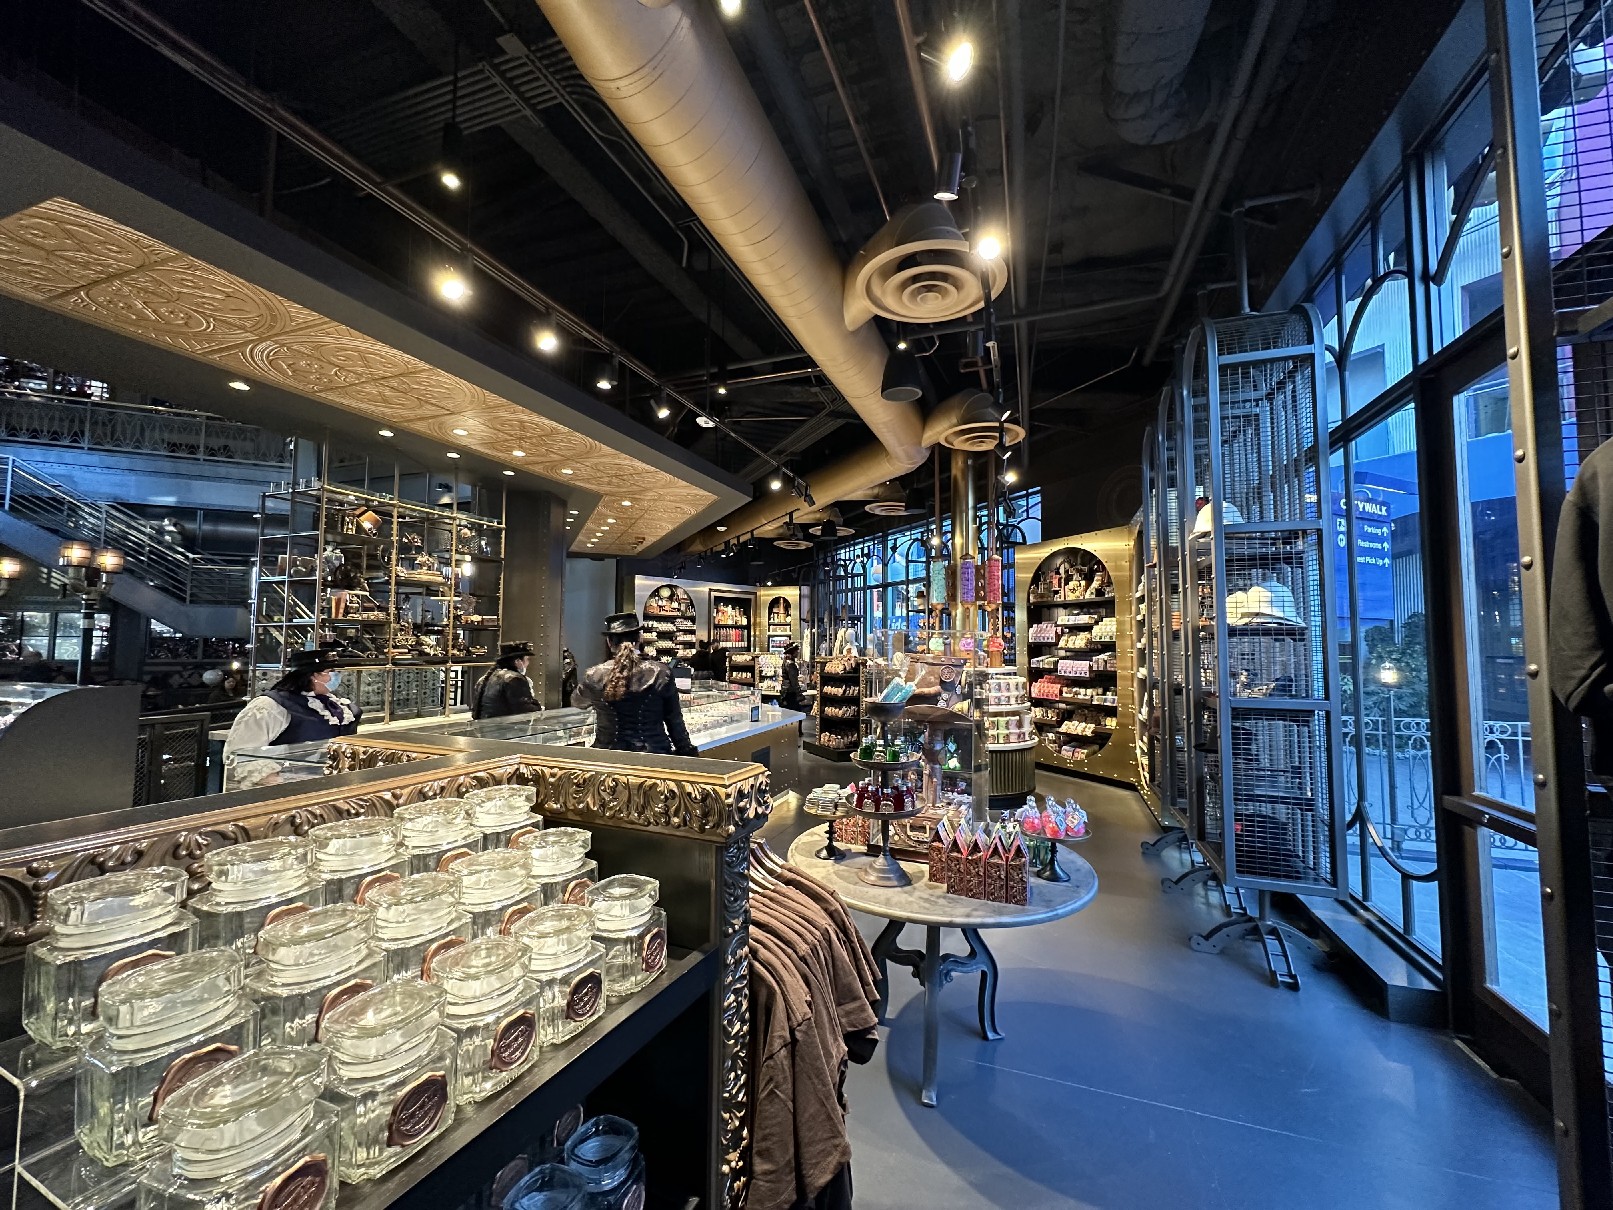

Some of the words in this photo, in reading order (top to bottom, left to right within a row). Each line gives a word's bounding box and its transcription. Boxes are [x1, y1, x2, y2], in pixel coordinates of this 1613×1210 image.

[1364, 525, 1382, 536] Parking
[1357, 539, 1382, 549] Restrooms
[1365, 556, 1376, 564] Pick
